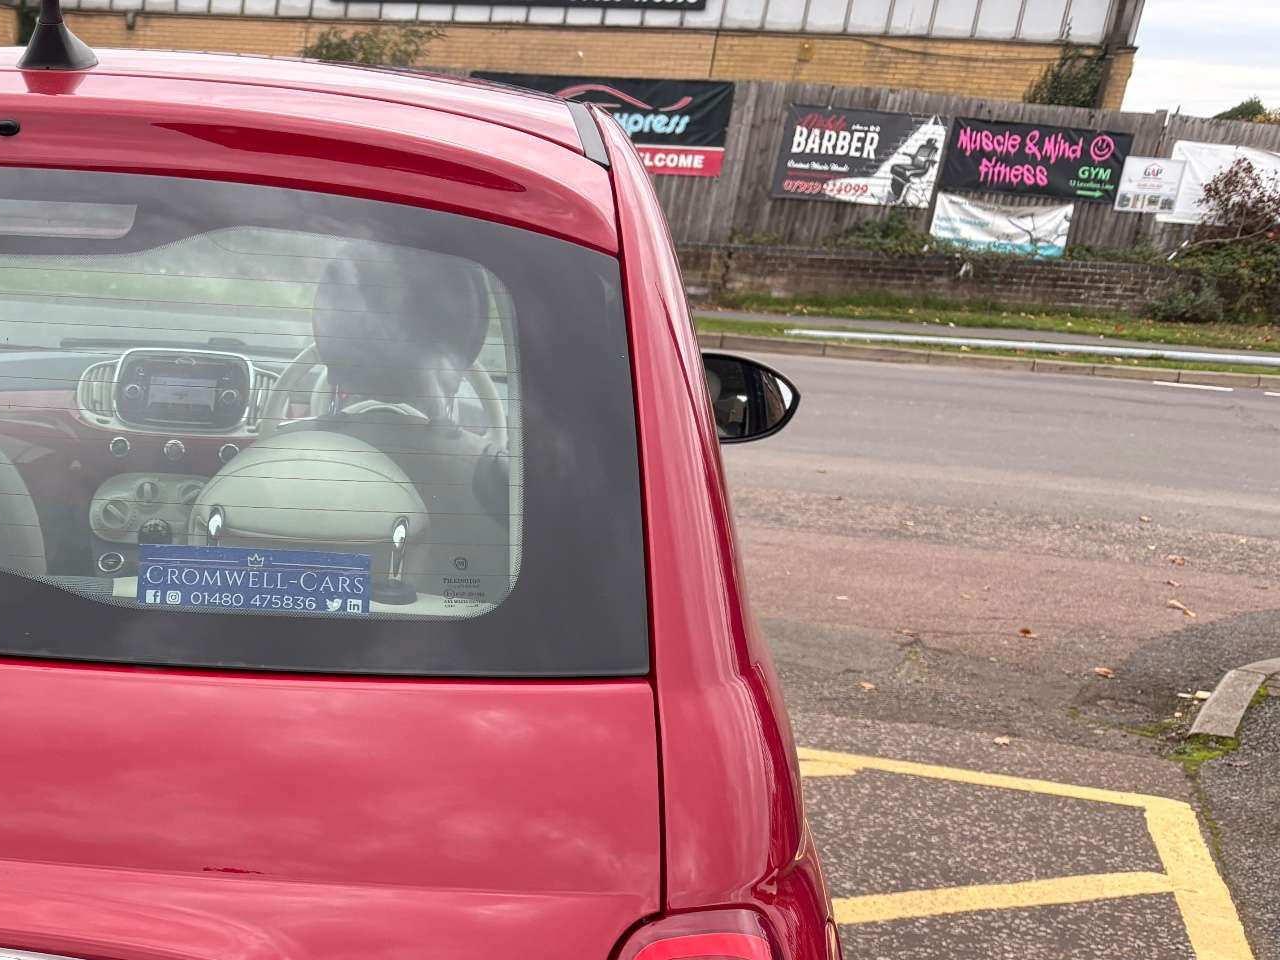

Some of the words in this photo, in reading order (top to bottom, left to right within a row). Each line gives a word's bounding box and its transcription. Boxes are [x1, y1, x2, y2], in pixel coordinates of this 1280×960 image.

[790, 124, 880, 160] BARBER
[956, 126, 1022, 157] Muscle
[1025, 129, 1042, 162] &
[1041, 132, 1084, 165] Mind
[1078, 166, 1112, 181] GYM
[190, 591, 244, 607] 01480
[250, 593, 316, 610] 475836
